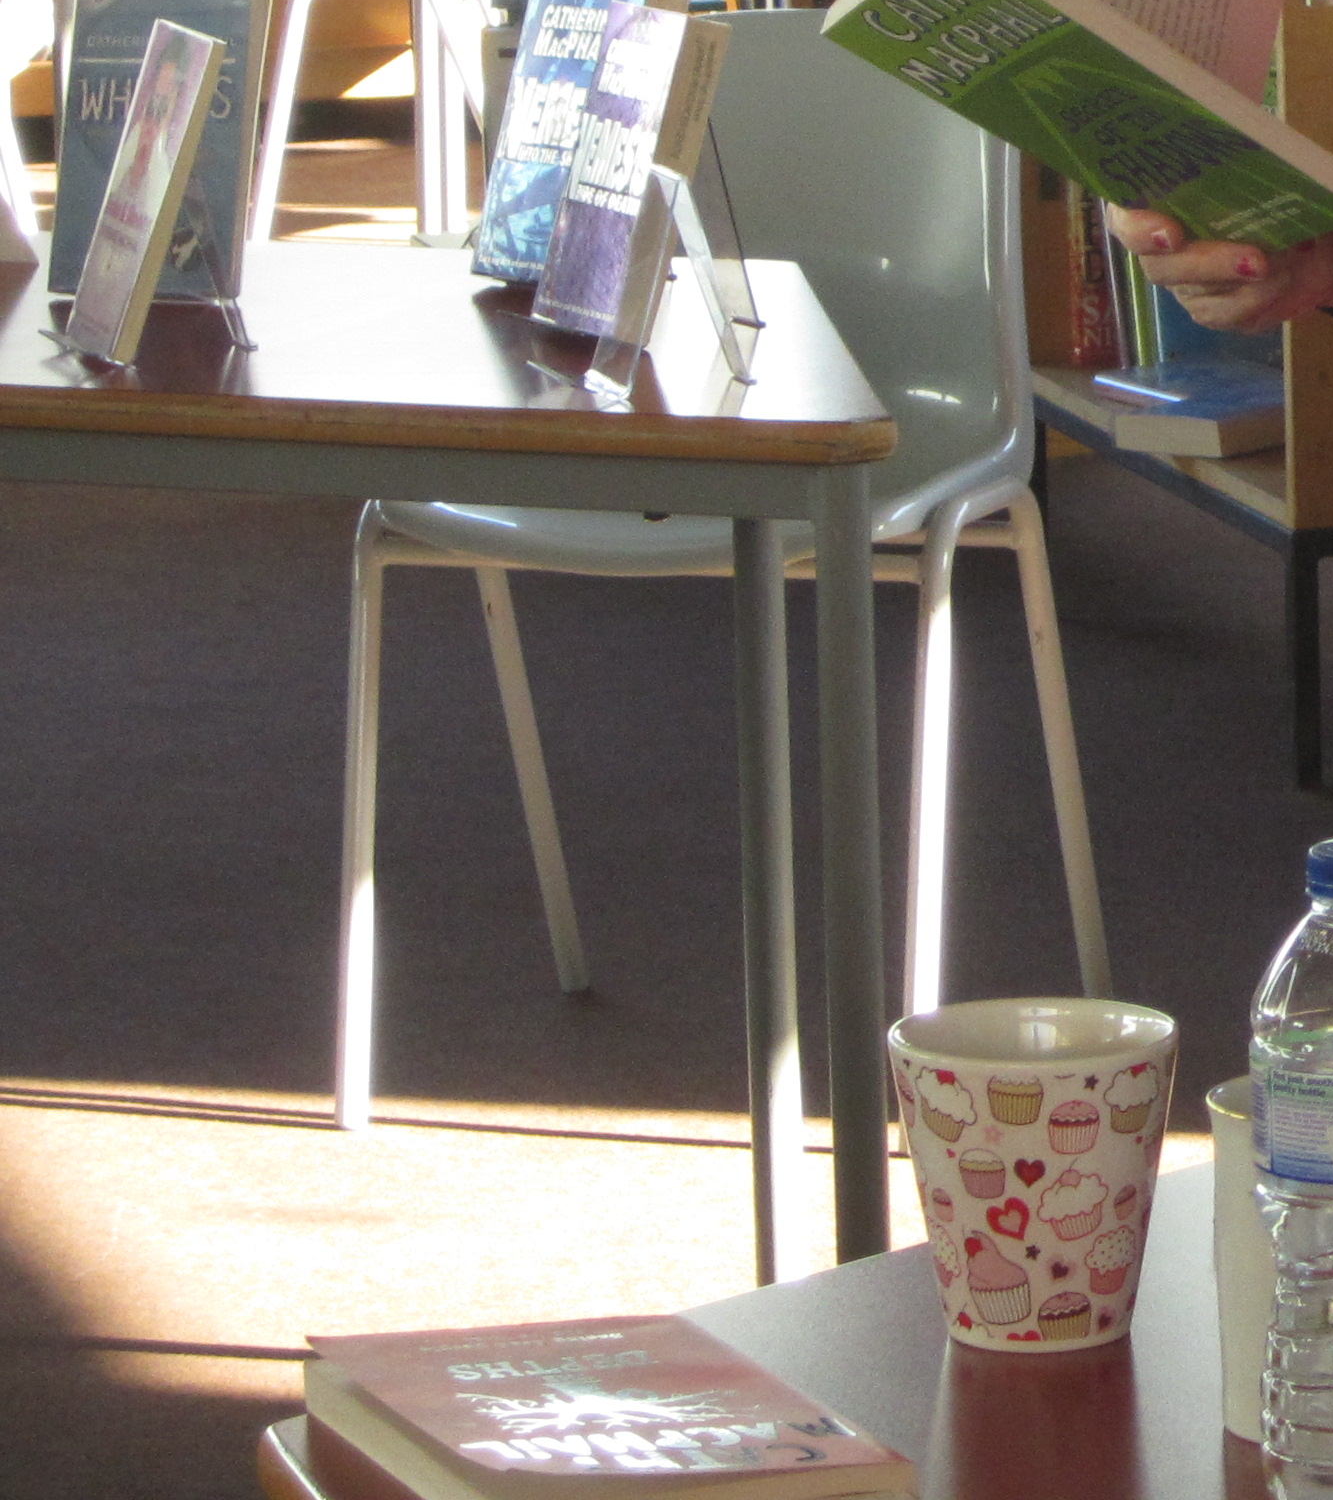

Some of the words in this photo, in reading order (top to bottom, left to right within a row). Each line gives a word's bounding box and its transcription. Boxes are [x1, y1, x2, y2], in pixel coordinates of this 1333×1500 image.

[505, 77, 588, 155] NEME
[447, 1349, 650, 1381] DEPTHS
[459, 1416, 858, 1460] MACPHAIL
